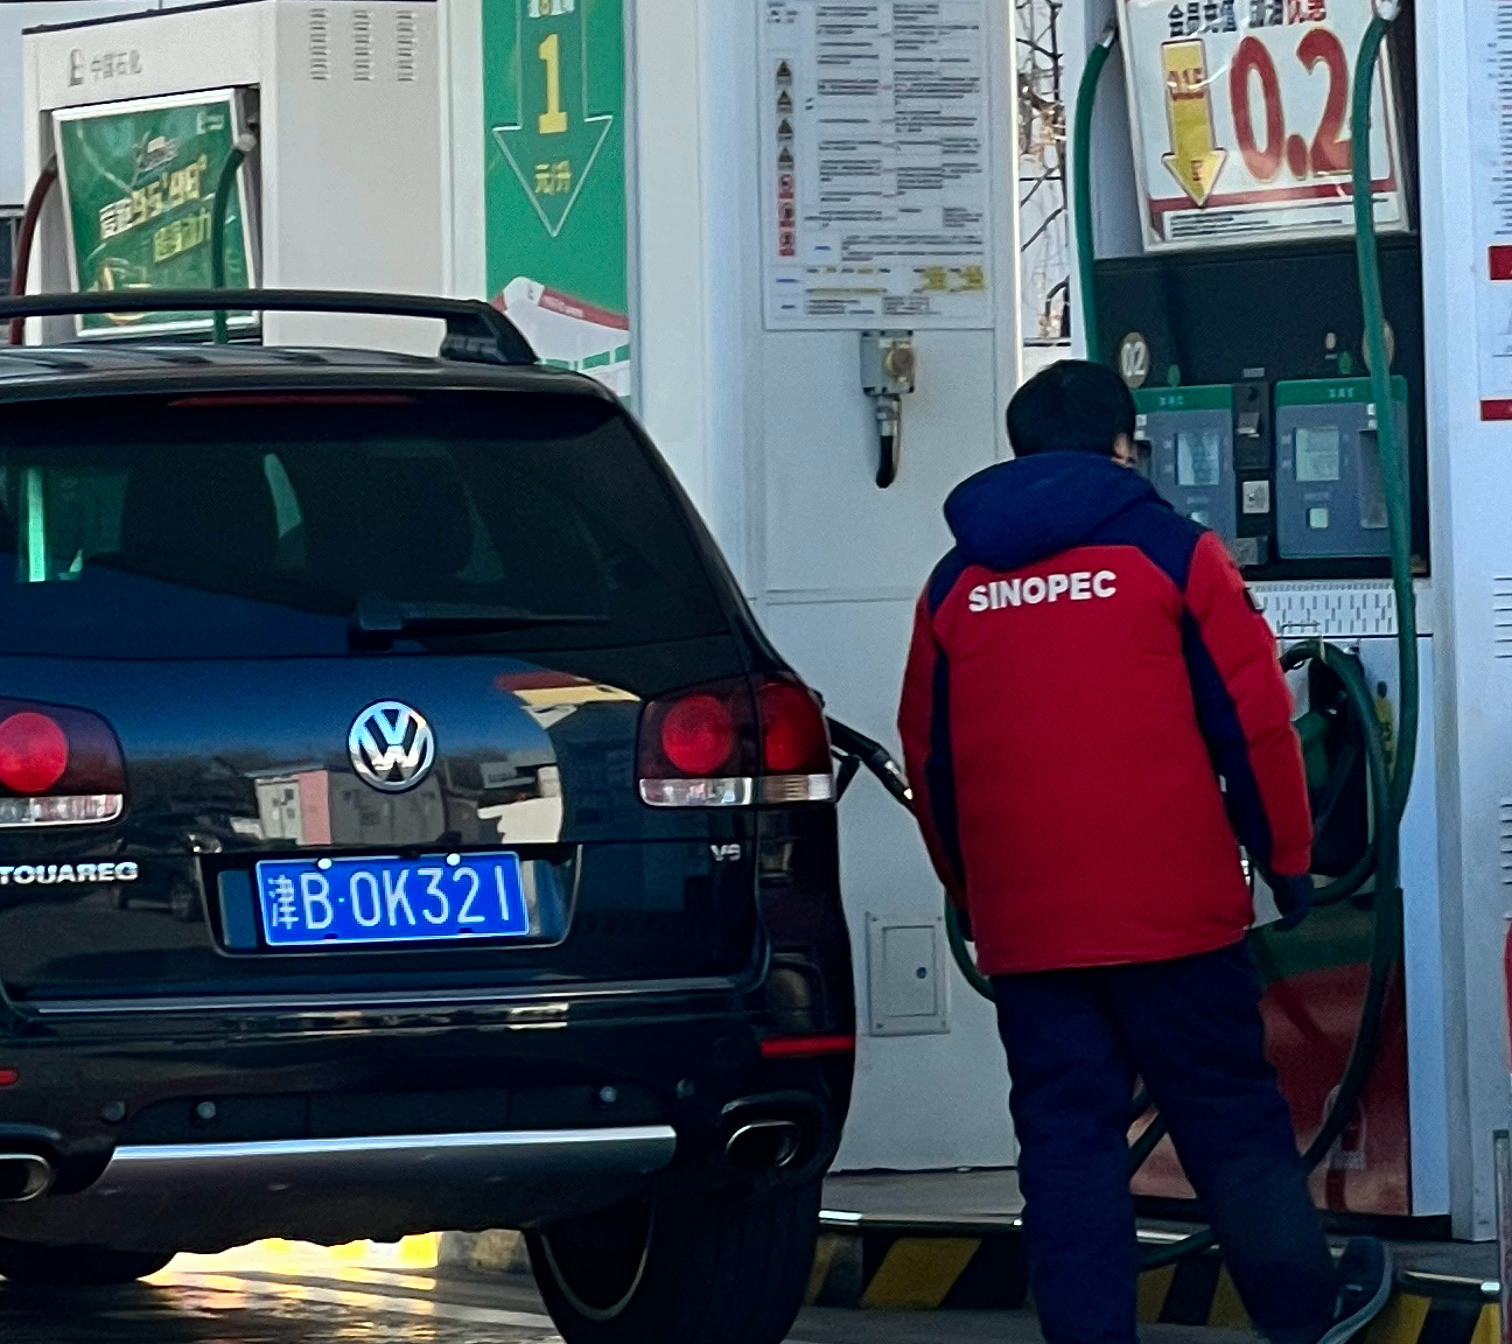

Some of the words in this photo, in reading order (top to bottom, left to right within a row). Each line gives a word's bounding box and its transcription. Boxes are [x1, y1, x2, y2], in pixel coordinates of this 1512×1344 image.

[538, 33, 569, 134] 1
[1120, 341, 1146, 377] 02
[968, 570, 1117, 613] SINOPEC
